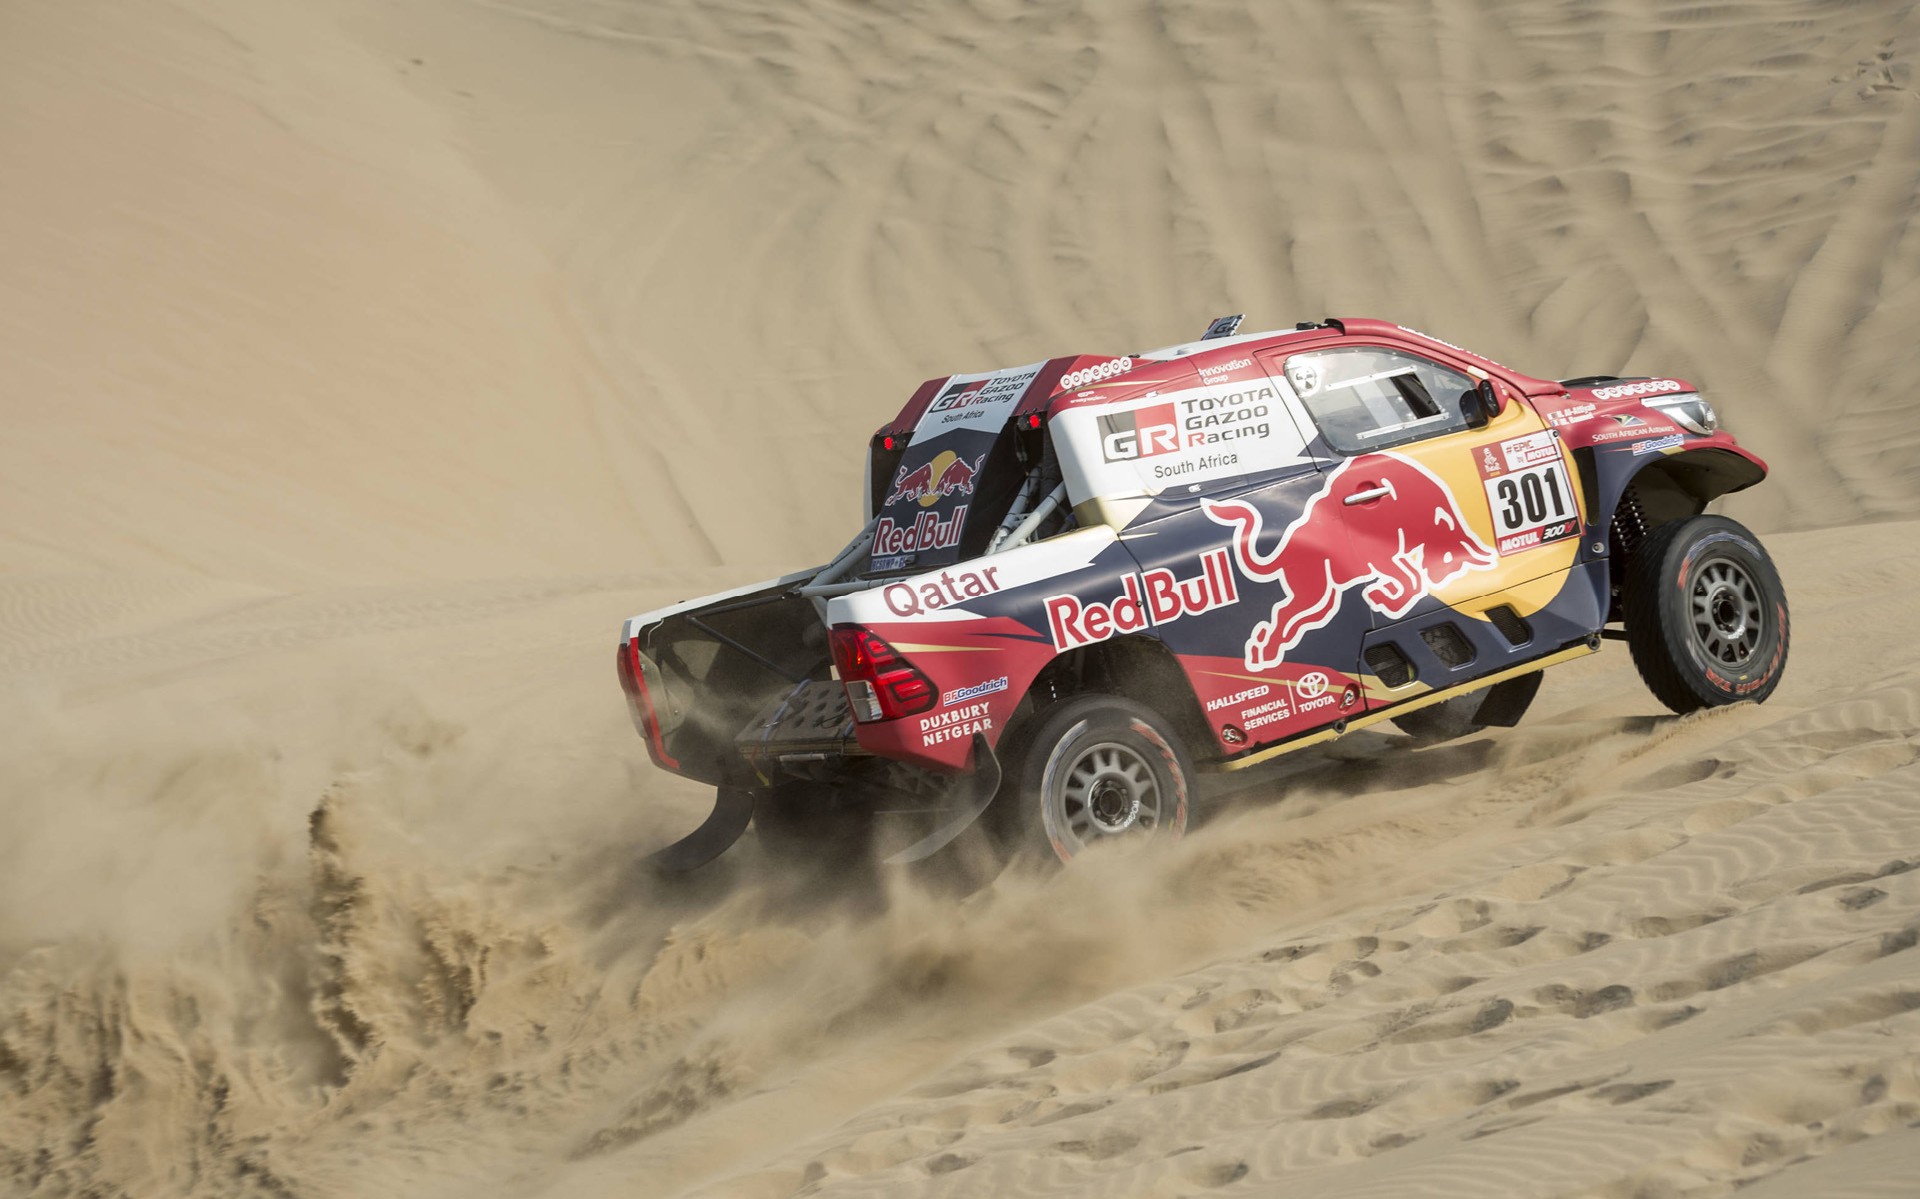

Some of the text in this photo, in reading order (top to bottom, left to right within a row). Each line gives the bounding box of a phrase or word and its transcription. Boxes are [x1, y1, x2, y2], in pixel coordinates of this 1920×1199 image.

[990, 371, 1037, 385] TOYOTA
[1061, 357, 1132, 389] ooredoo
[1198, 358, 1252, 377] Innovation
[1203, 374, 1229, 385] Group
[932, 390, 979, 411] GR
[970, 393, 1015, 405] Racing
[980, 382, 1025, 395] GAZOO
[1181, 387, 1273, 414] TOYOTA
[941, 410, 985, 424] South Africa
[1185, 405, 1268, 431] GAZOO
[1103, 423, 1178, 460] GR
[1188, 423, 1270, 447] Racing
[1592, 426, 1675, 442] SOUTH AFRICAN AIRWAYS
[1154, 453, 1238, 479] South Africa
[1527, 447, 1556, 461] MOTUL
[1497, 467, 1565, 529] 301
[872, 505, 968, 556] Red Bull
[1501, 521, 1576, 552] MOTUL 300V
[883, 566, 1001, 617] Qatar
[1044, 548, 1239, 652] Red Bull
[1206, 685, 1270, 712] HALLSPEED
[1241, 699, 1288, 719] FINANCIAL
[1299, 695, 1335, 713] TOYOTA
[920, 702, 989, 731] DUXBURY
[1244, 709, 1290, 730] SERVICES
[923, 718, 993, 747] NETGEAR
